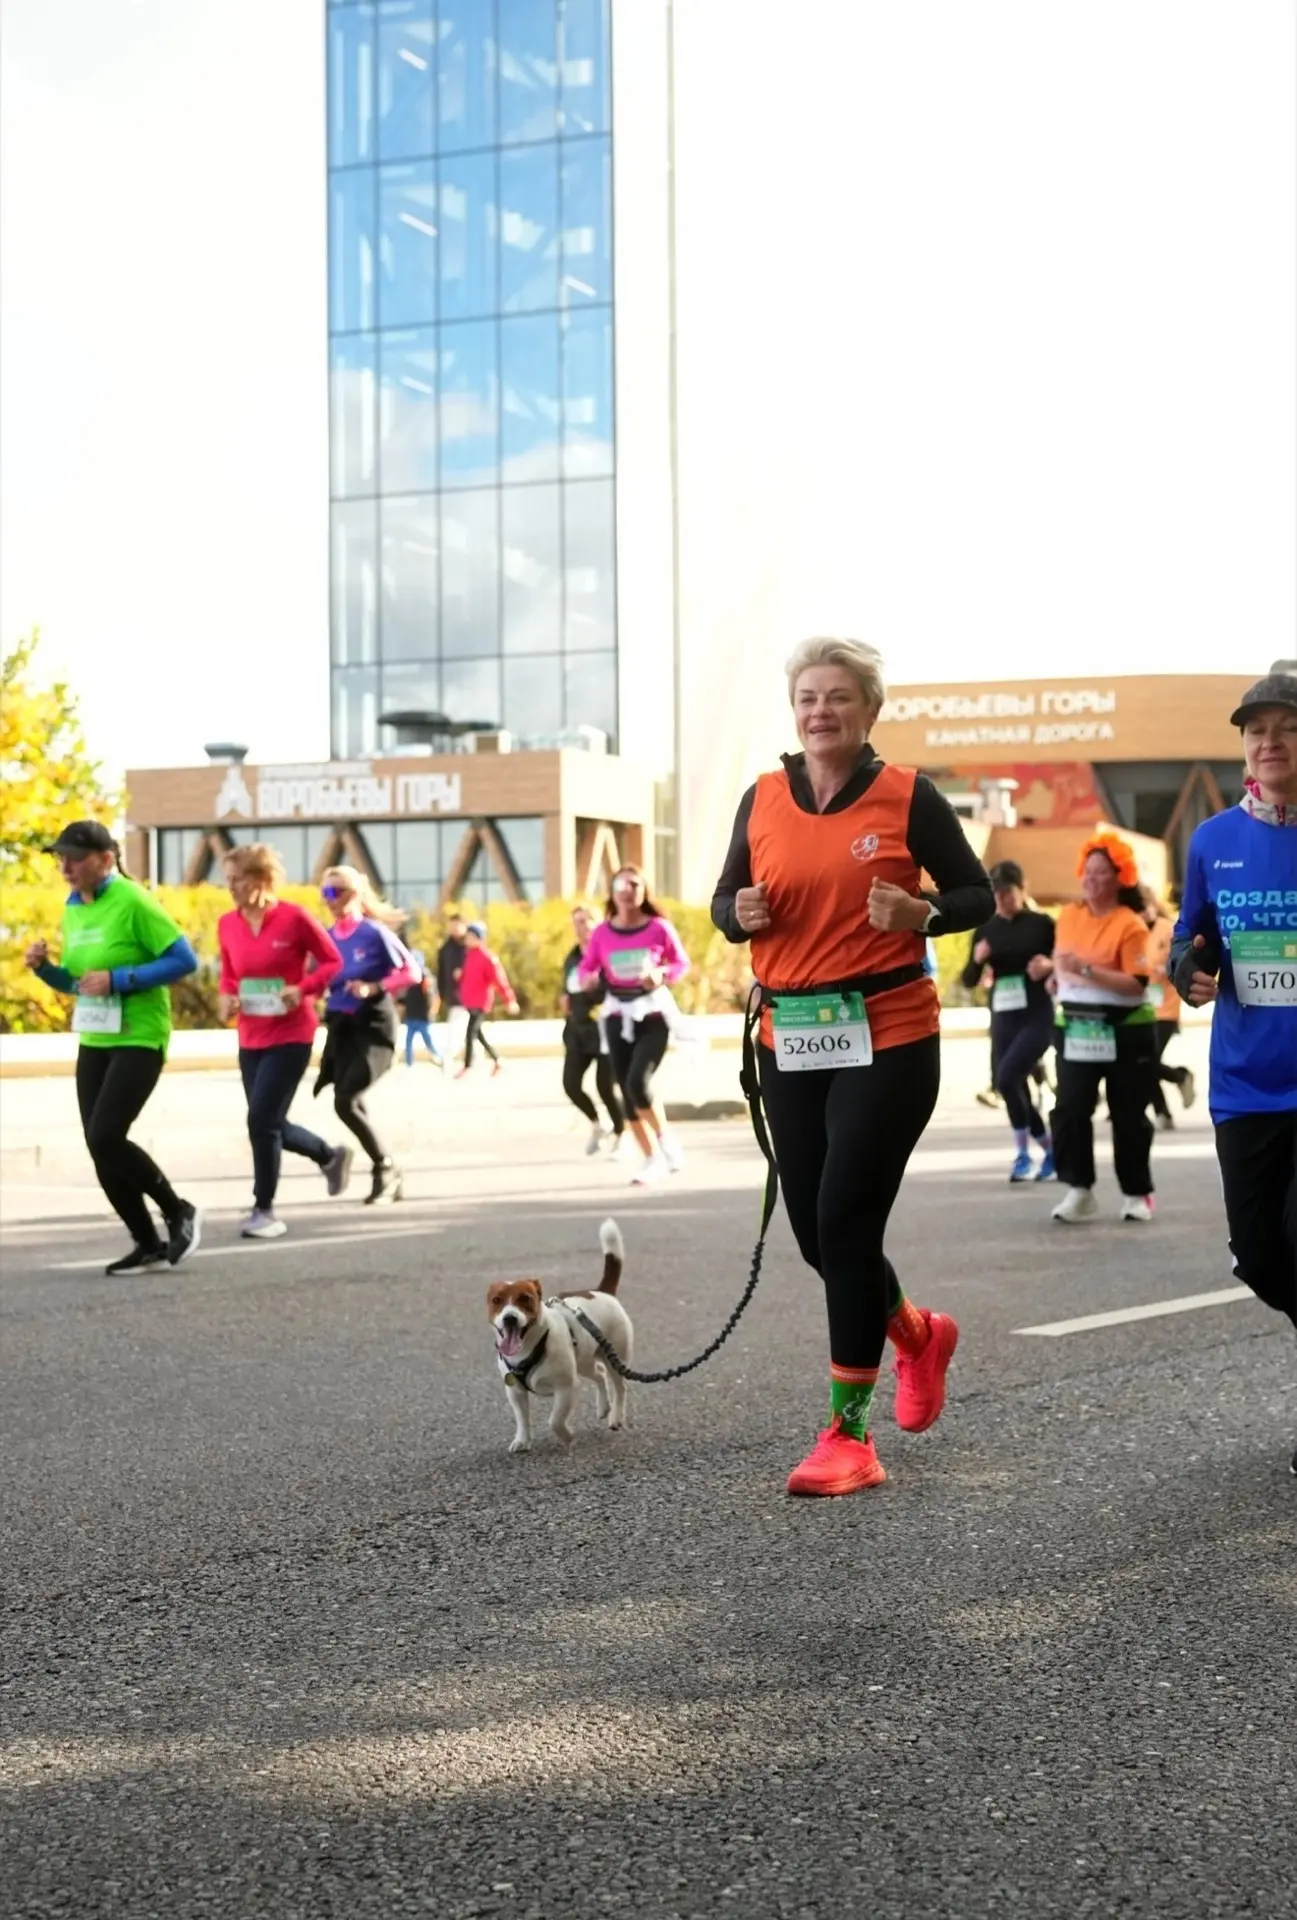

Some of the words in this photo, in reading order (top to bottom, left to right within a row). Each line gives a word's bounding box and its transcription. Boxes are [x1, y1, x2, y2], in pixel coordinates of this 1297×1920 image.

[1040, 689, 1116, 715] ГОРЫ
[1033, 721, 1114, 745] ДОРОГА
[396, 772, 461, 814] ГОРЫ
[1216, 889, 1297, 908] Созда
[1253, 912, 1297, 926] что
[1247, 971, 1296, 990] 5170
[783, 1033, 851, 1055] 52606
